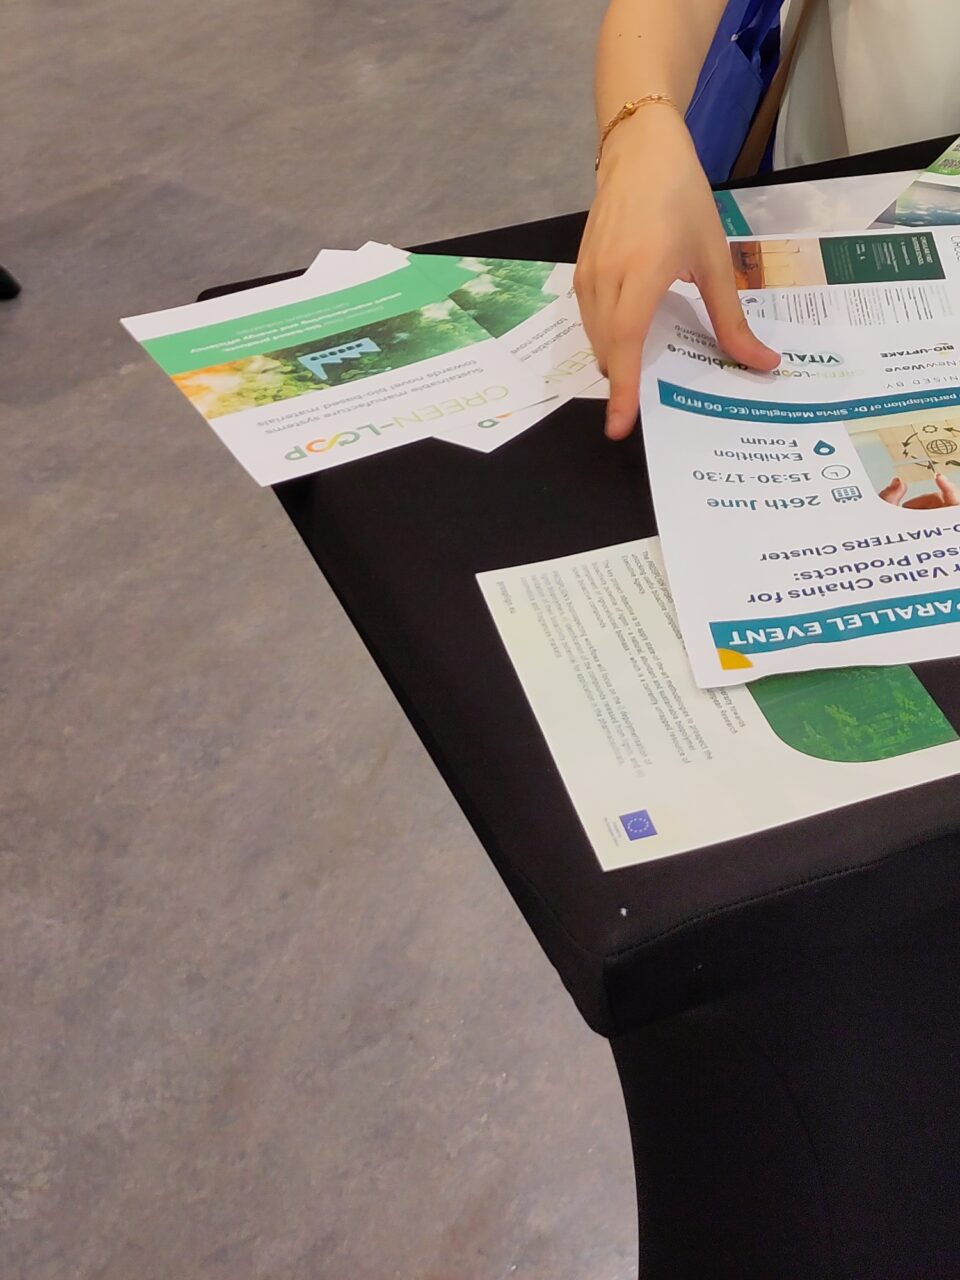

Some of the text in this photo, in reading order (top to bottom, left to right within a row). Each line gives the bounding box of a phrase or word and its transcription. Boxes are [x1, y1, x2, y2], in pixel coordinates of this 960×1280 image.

[782, 351, 840, 364] VITAL
[880, 344, 954, 358] BIO-UPTAKE
[884, 358, 957, 373] NewWave
[255, 358, 478, 428] towards novel bio-based materials
[886, 381, 905, 389] BY
[262, 367, 486, 436] Sustainable manufacture systems
[704, 402, 723, 412] DG
[816, 407, 849, 416] Silvia
[283, 384, 511, 461] GREEN-LOOP
[739, 436, 799, 449] Forum
[713, 449, 804, 463] Exhibition
[706, 494, 822, 511] 26th June
[759, 543, 838, 562] Cluster
[793, 550, 911, 581] Products:
[879, 563, 949, 585] Value
[747, 587, 783, 604] for
[788, 575, 874, 599] Chains
[729, 620, 822, 646] EVENT
